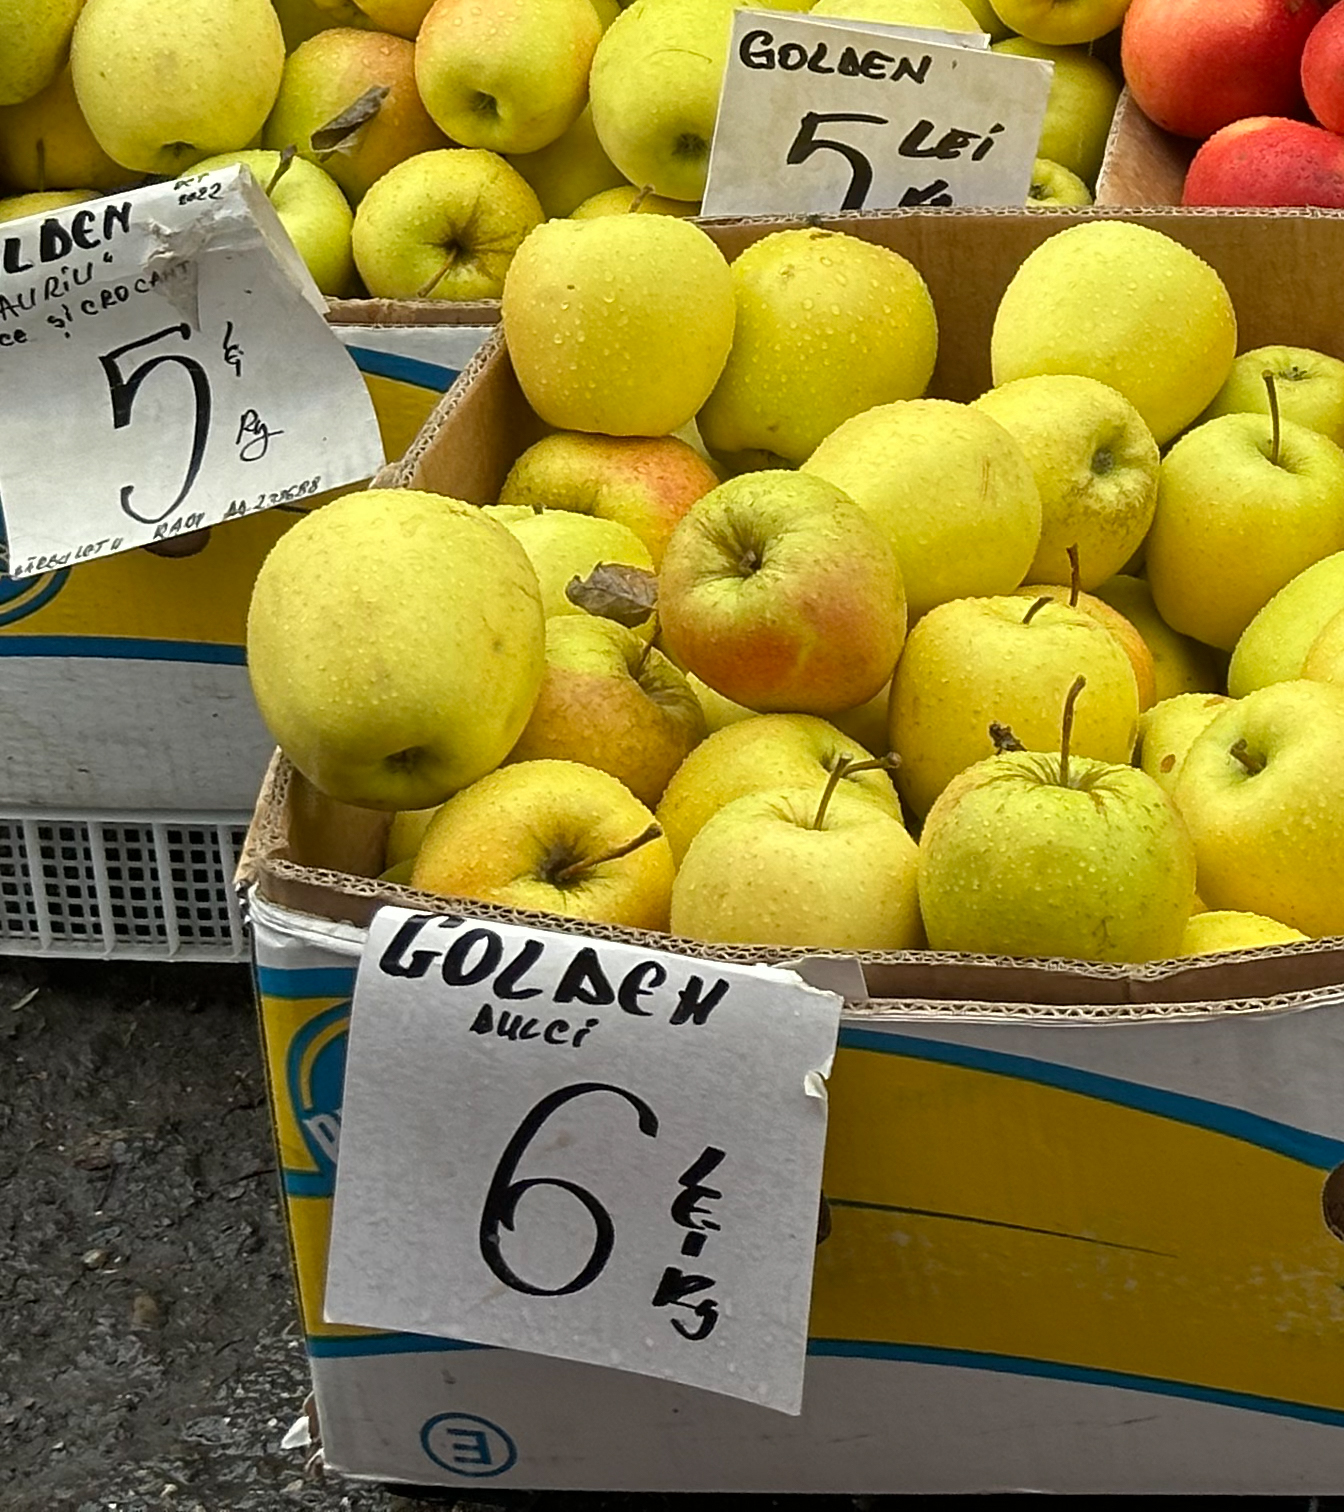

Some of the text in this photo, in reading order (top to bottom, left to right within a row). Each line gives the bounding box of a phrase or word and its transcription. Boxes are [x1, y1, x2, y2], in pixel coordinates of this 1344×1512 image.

[739, 29, 932, 85] GOLDEN
[786, 111, 889, 211] 5
[99, 323, 212, 525] 5
[378, 912, 731, 1027] GOLDEN
[478, 1081, 660, 1298] 6
